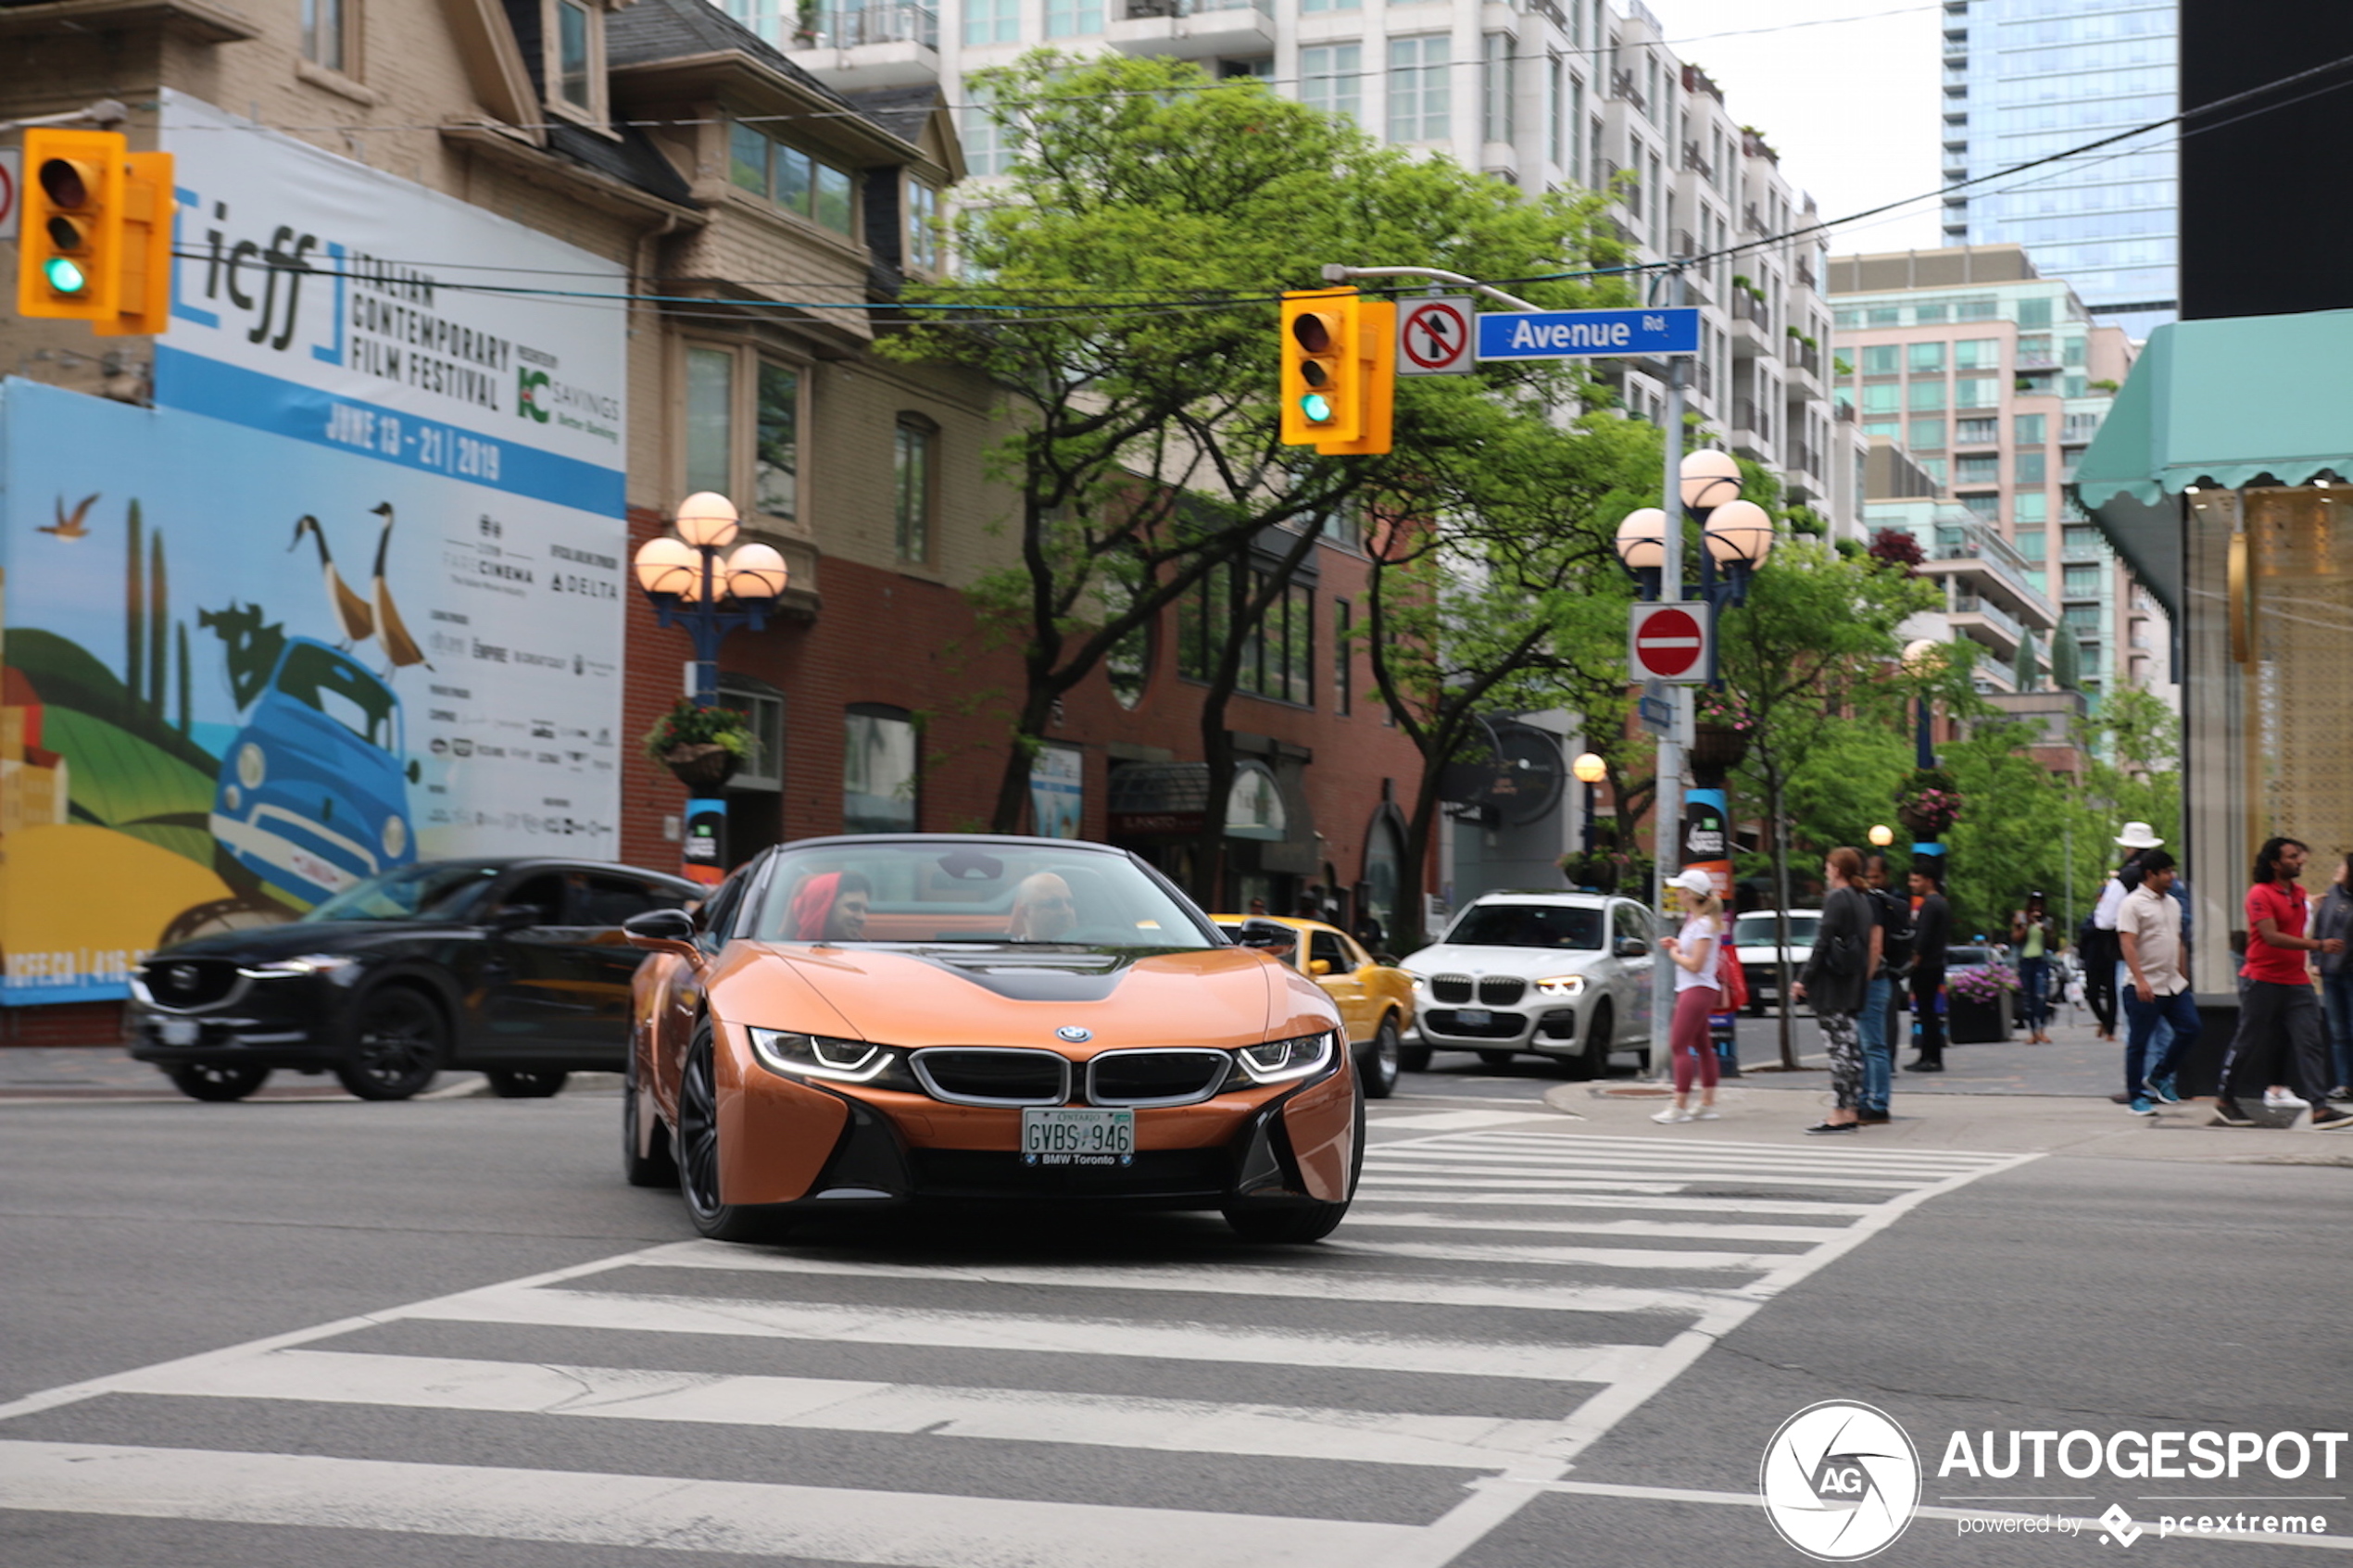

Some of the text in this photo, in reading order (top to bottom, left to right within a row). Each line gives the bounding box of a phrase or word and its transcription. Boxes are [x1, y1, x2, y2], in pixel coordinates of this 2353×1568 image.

[352, 250, 434, 308] ITALIAN
[352, 291, 511, 373] CONTEMPORARY
[1511, 314, 1666, 349] Avenue Rd
[352, 334, 401, 383] FILM
[409, 351, 500, 412] FESTIVAL
[553, 381, 620, 422] SAVINGS
[326, 402, 375, 450] JUNE
[379, 416, 401, 457] 13
[420, 425, 442, 467] 21
[457, 435, 500, 482] 2019
[567, 573, 619, 600] DELTA
[1057, 1111, 1101, 1123] ONTARIO
[1028, 1123, 1129, 1152] GVBS 946
[1042, 1154, 1115, 1165] BMW Toronto
